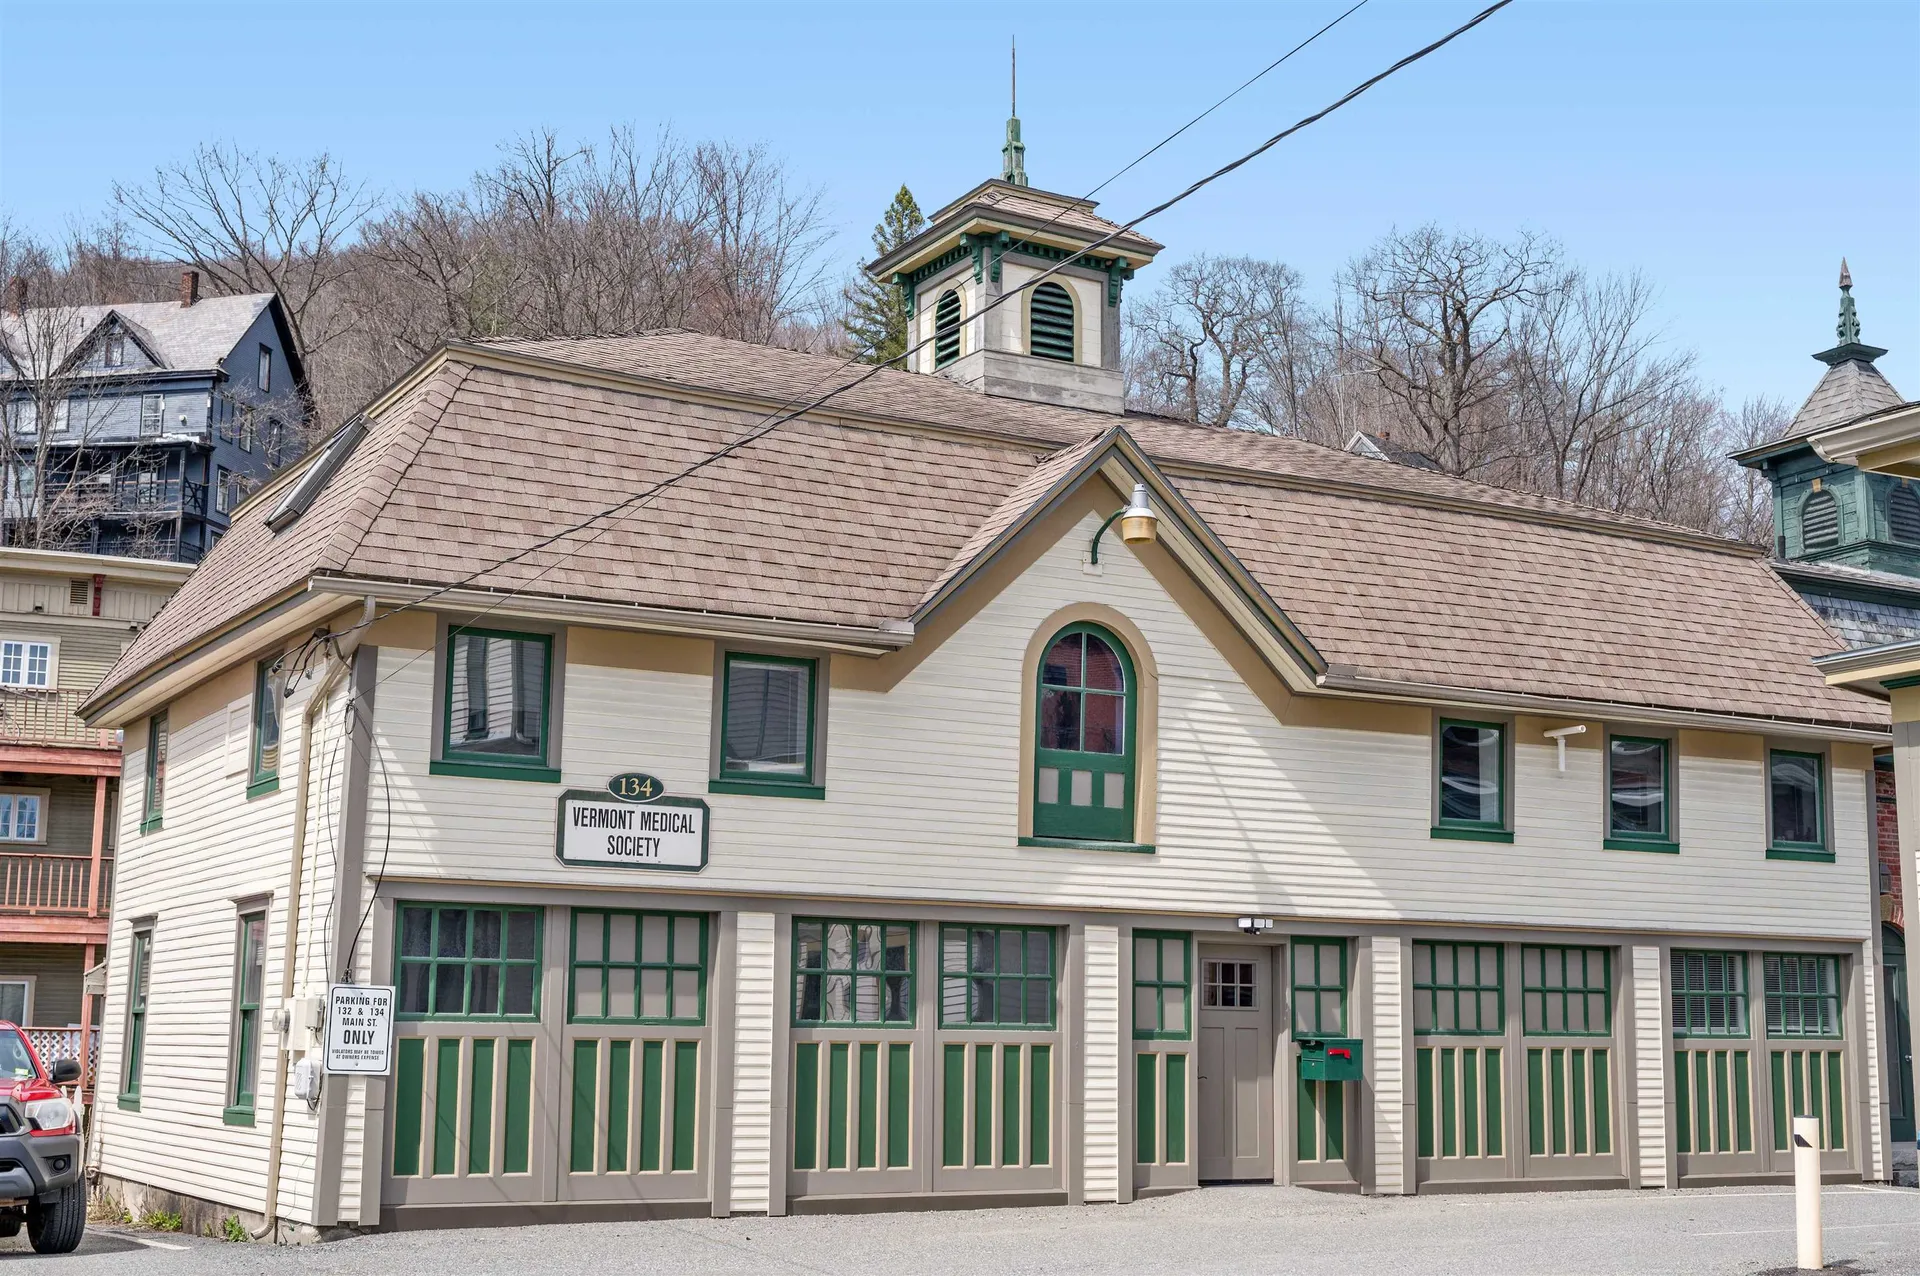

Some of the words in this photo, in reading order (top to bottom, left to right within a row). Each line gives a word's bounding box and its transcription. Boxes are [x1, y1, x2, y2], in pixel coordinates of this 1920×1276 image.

[619, 777, 653, 797] 134
[573, 807, 635, 830] VERMONT
[640, 811, 695, 834] MEDICAL
[607, 835, 660, 857] SOCIETY
[335, 996, 370, 1006] PARKING
[373, 997, 388, 1006] FOR
[338, 1006, 352, 1015] 132
[370, 1008, 384, 1016] 134
[342, 1017, 364, 1026] MAIN
[367, 1018, 378, 1027] ST.
[343, 1029, 375, 1045] ONLY
